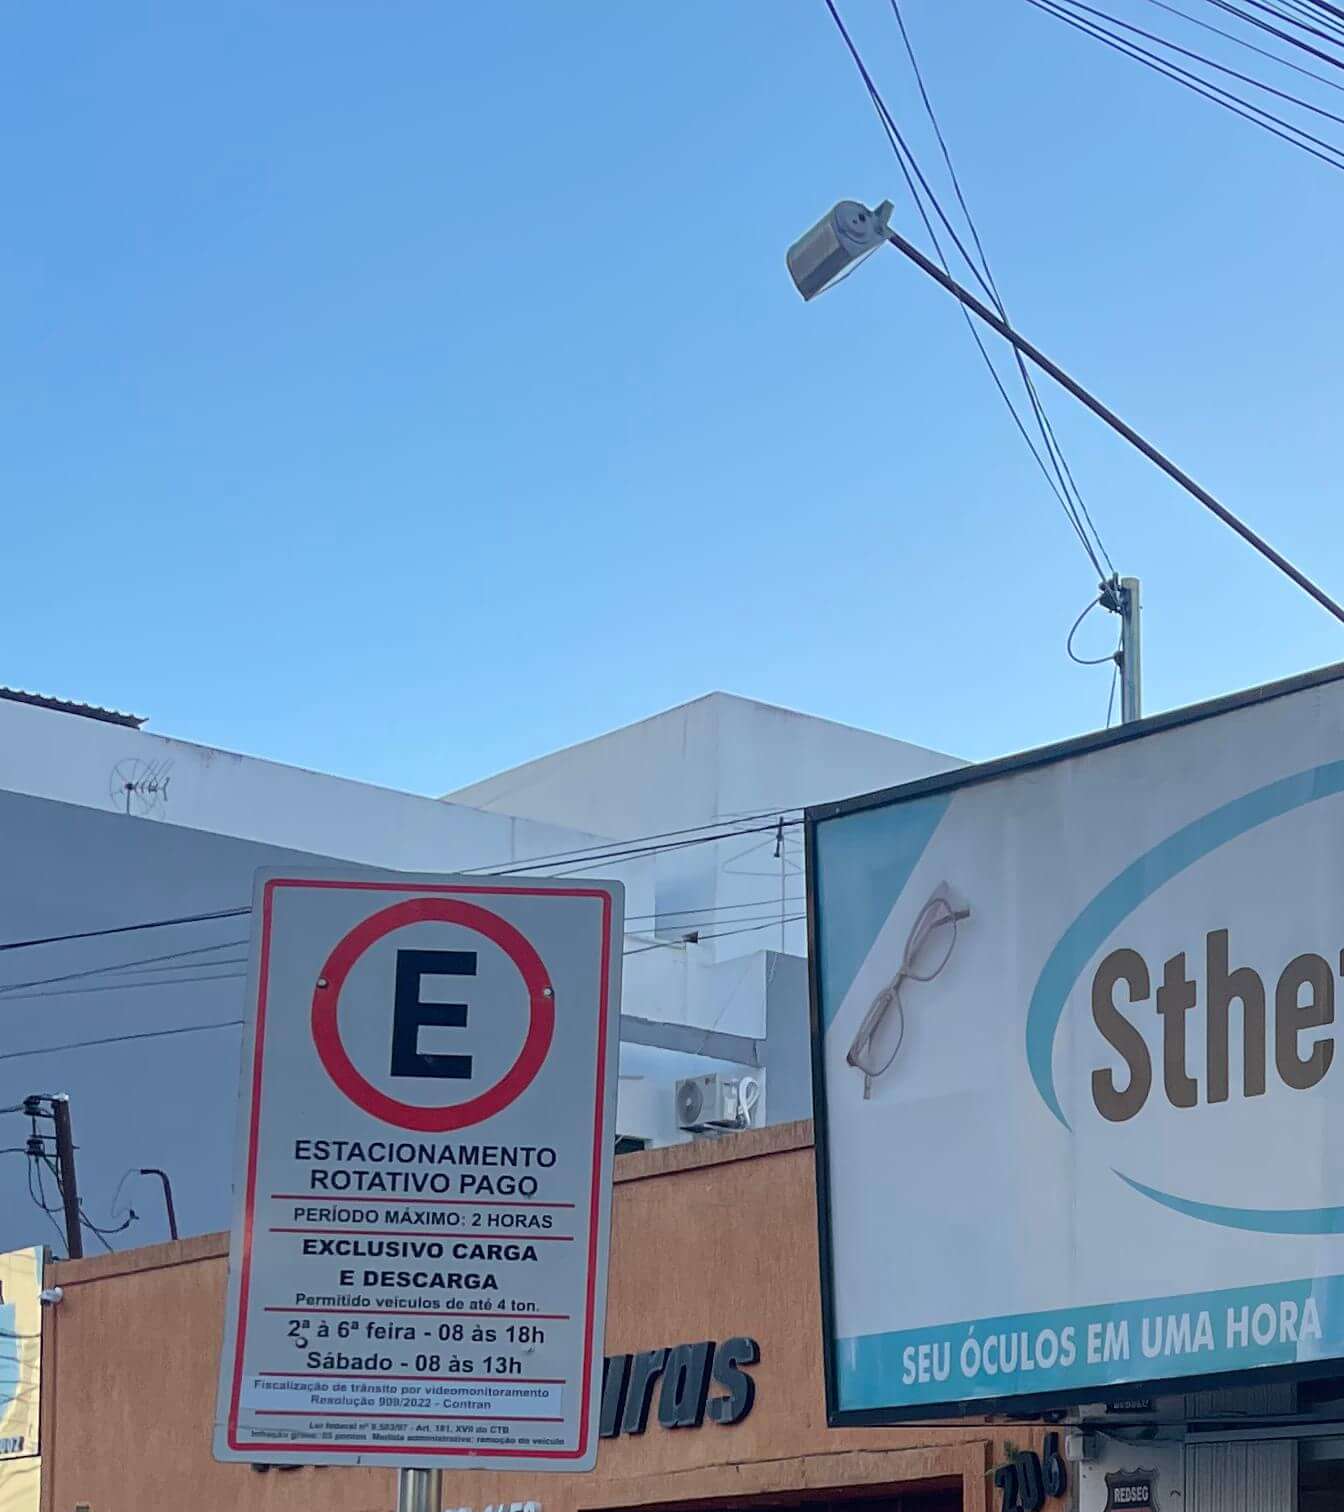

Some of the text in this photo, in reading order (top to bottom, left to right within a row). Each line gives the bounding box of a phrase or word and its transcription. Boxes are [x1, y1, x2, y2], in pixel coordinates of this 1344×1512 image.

[390, 949, 477, 1079] E
[294, 1139, 557, 1168] ESTACIONAMENTO
[310, 1169, 538, 1196] ROTATIVO PAGO
[294, 1205, 553, 1229] PERÍODO MÁXIMO: 2 HORAS
[302, 1239, 538, 1262] EXCLUSIVO CARGA
[339, 1270, 499, 1290] E DESCARGA
[295, 1293, 371, 1307] Permitido
[446, 1297, 464, 1310] de
[469, 1298, 492, 1311] até
[497, 1299, 506, 1311] 4
[511, 1300, 540, 1312] ton.
[287, 1320, 310, 1338] 2ª
[317, 1321, 329, 1338] à
[337, 1321, 359, 1339] 6ª
[366, 1321, 417, 1340] feira
[438, 1323, 464, 1341] 08
[471, 1323, 497, 1343] às
[505, 1325, 545, 1344] 18h
[902, 1297, 1323, 1386] SEU ÓCULOS EM UMA HORA
[306, 1351, 393, 1371] Sábado
[415, 1354, 441, 1372] 08
[449, 1354, 474, 1374] às
[483, 1356, 522, 1375] 13h
[254, 1379, 329, 1392] Fiscalização
[333, 1383, 347, 1392] de
[351, 1383, 398, 1394] trânsito
[401, 1386, 422, 1396] por
[443, 1399, 492, 1410] Contran
[1114, 1486, 1149, 1503] REDSEG
